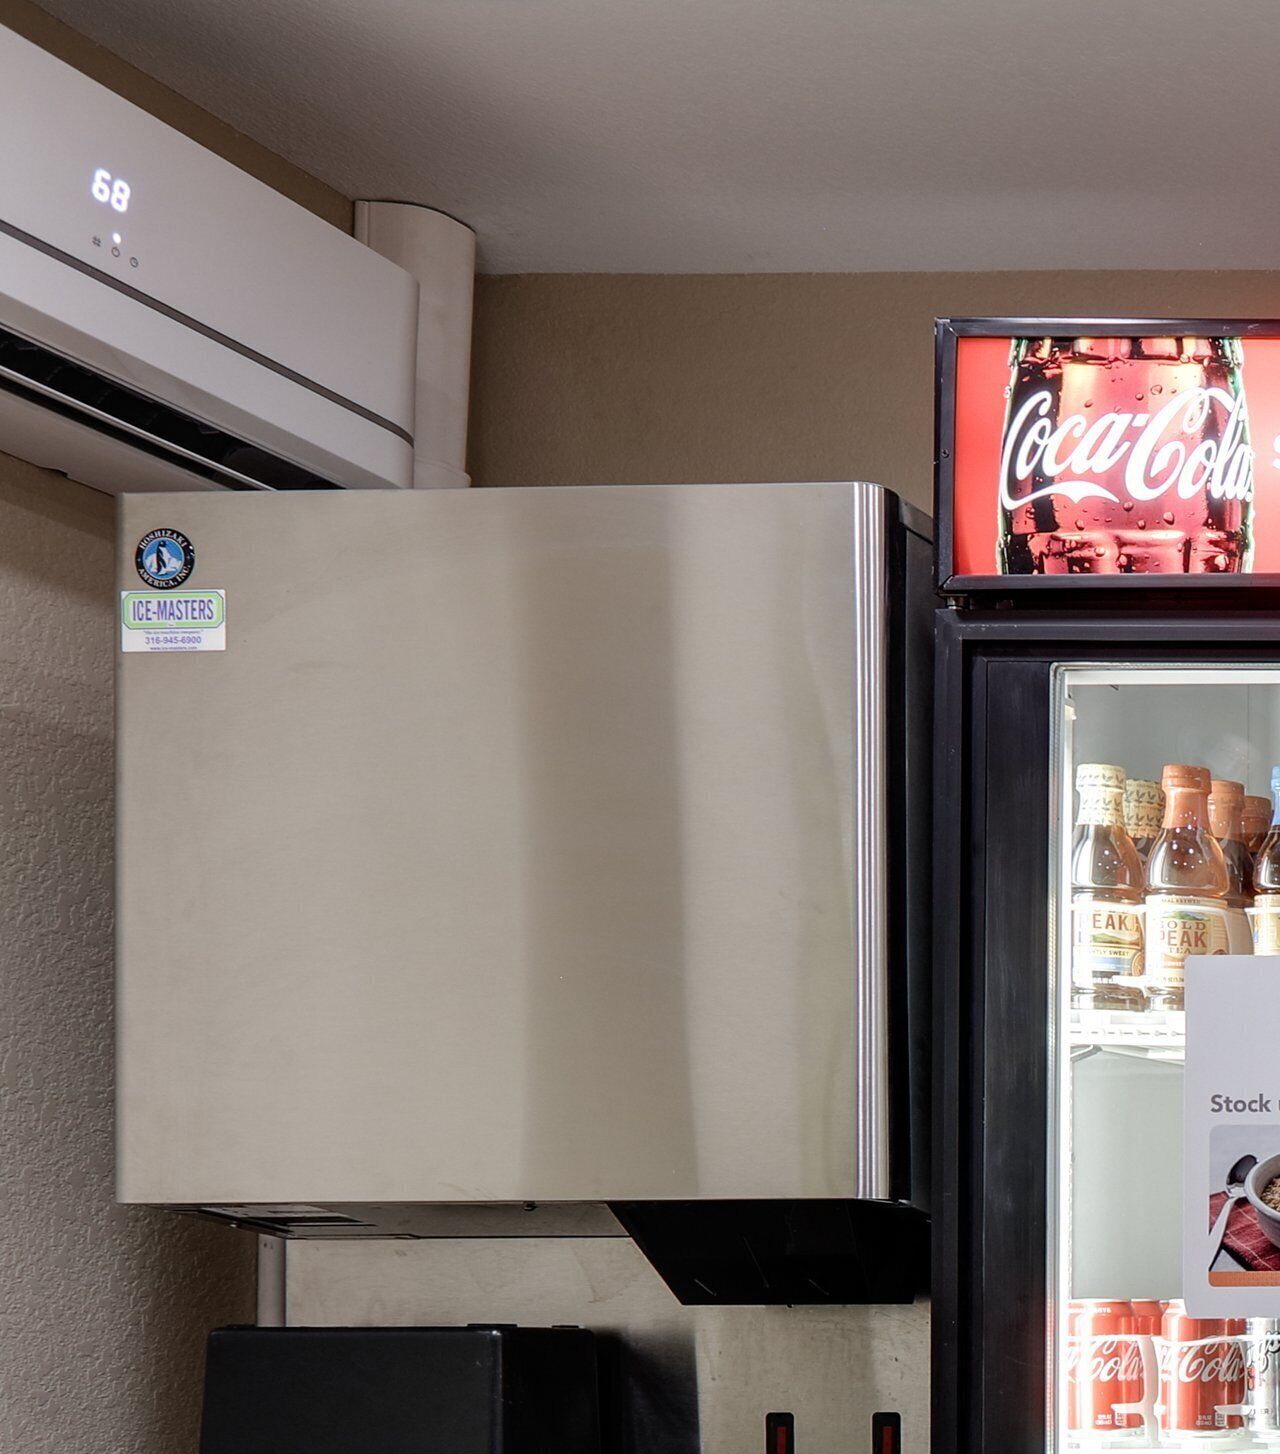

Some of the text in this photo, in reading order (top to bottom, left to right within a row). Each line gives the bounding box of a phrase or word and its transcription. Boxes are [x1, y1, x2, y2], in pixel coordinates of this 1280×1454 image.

[91, 167, 132, 214] 68
[1001, 386, 1256, 511] Coca-Cola
[139, 529, 188, 550] HOSHIZAKI
[132, 599, 214, 621] ICE-MASTERS
[1210, 1094, 1271, 1113] Stock
